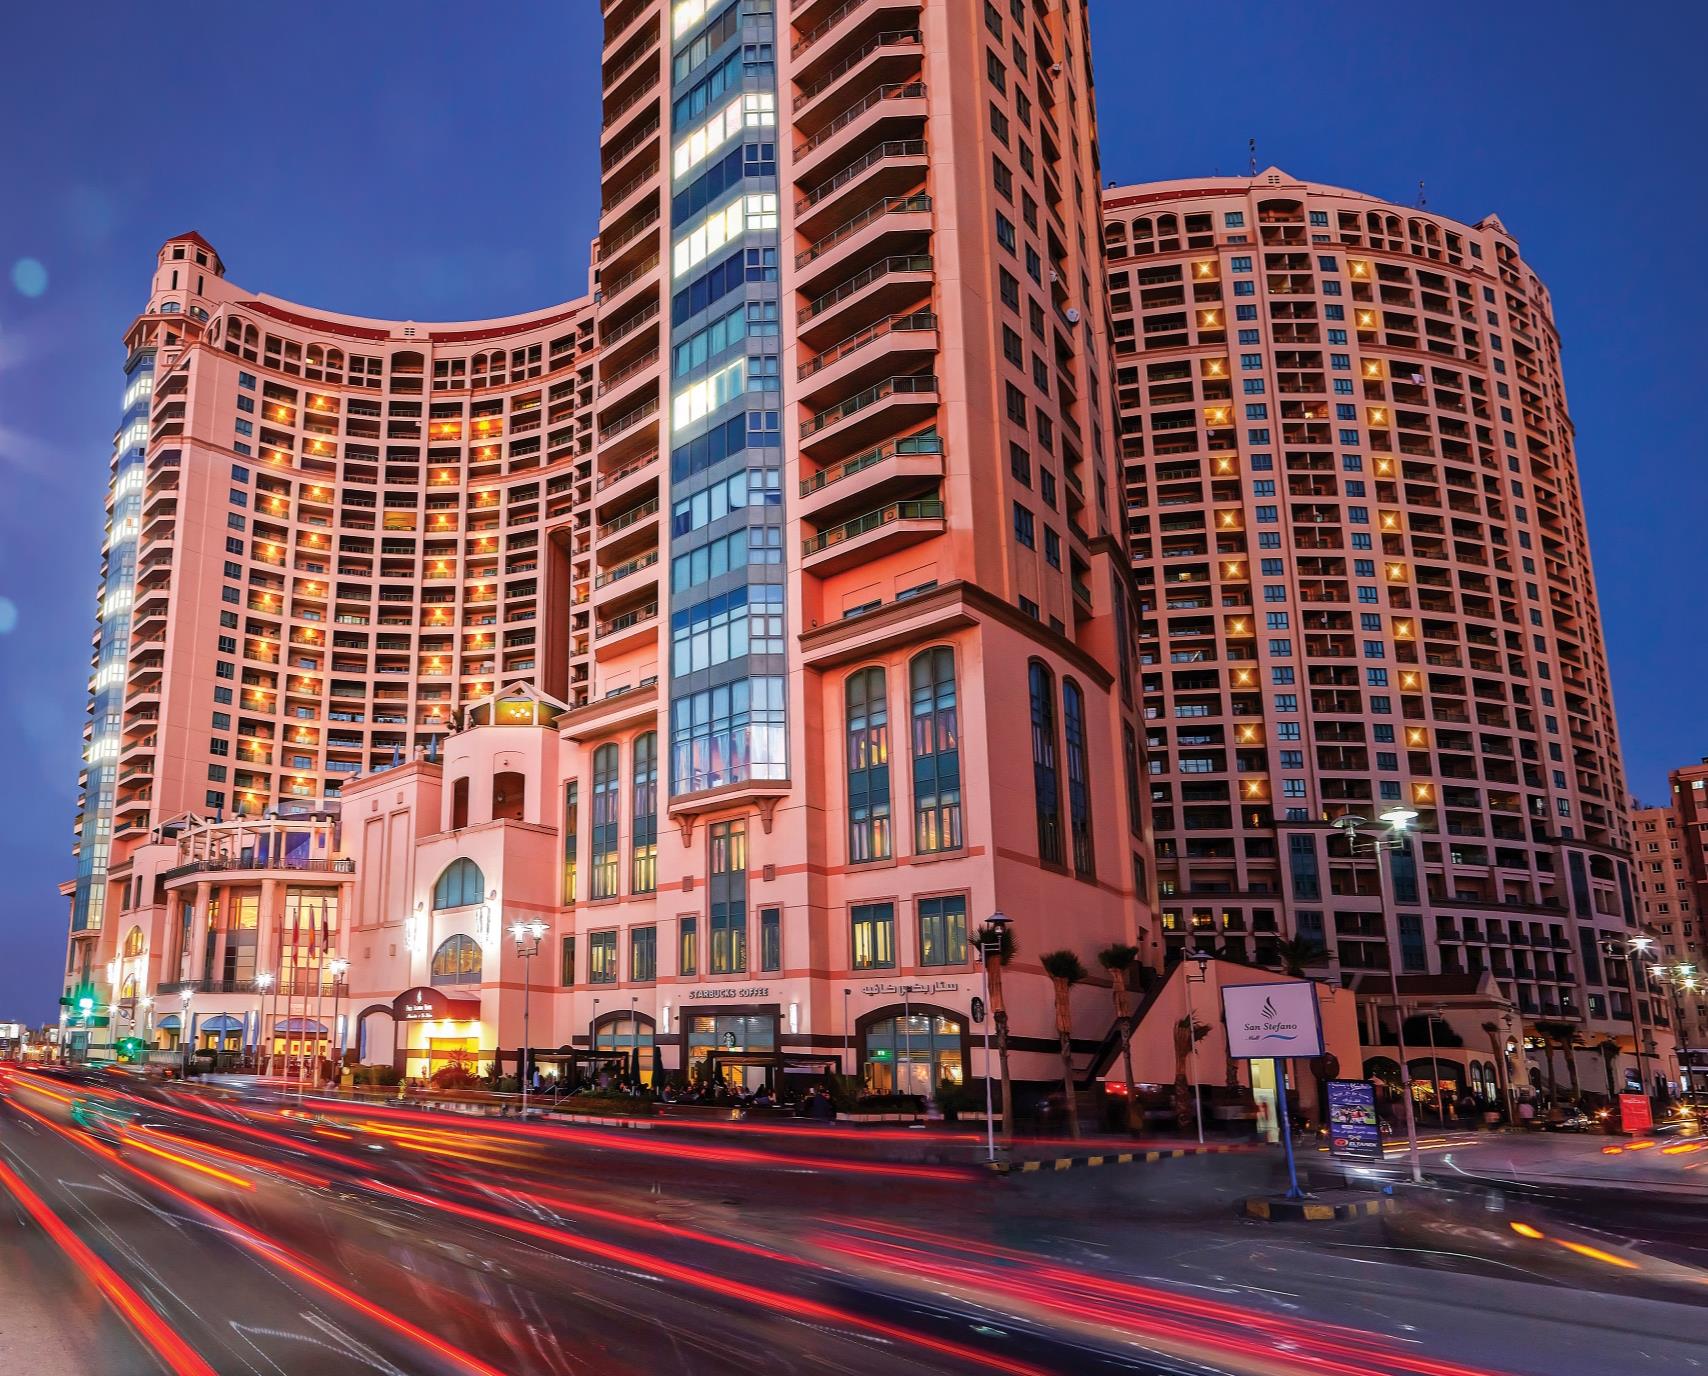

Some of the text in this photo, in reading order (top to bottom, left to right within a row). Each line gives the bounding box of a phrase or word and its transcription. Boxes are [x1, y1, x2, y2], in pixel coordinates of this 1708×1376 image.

[689, 987, 769, 999] STARBUCKS COFFEE
[1243, 1022, 1298, 1033] San Stefano
